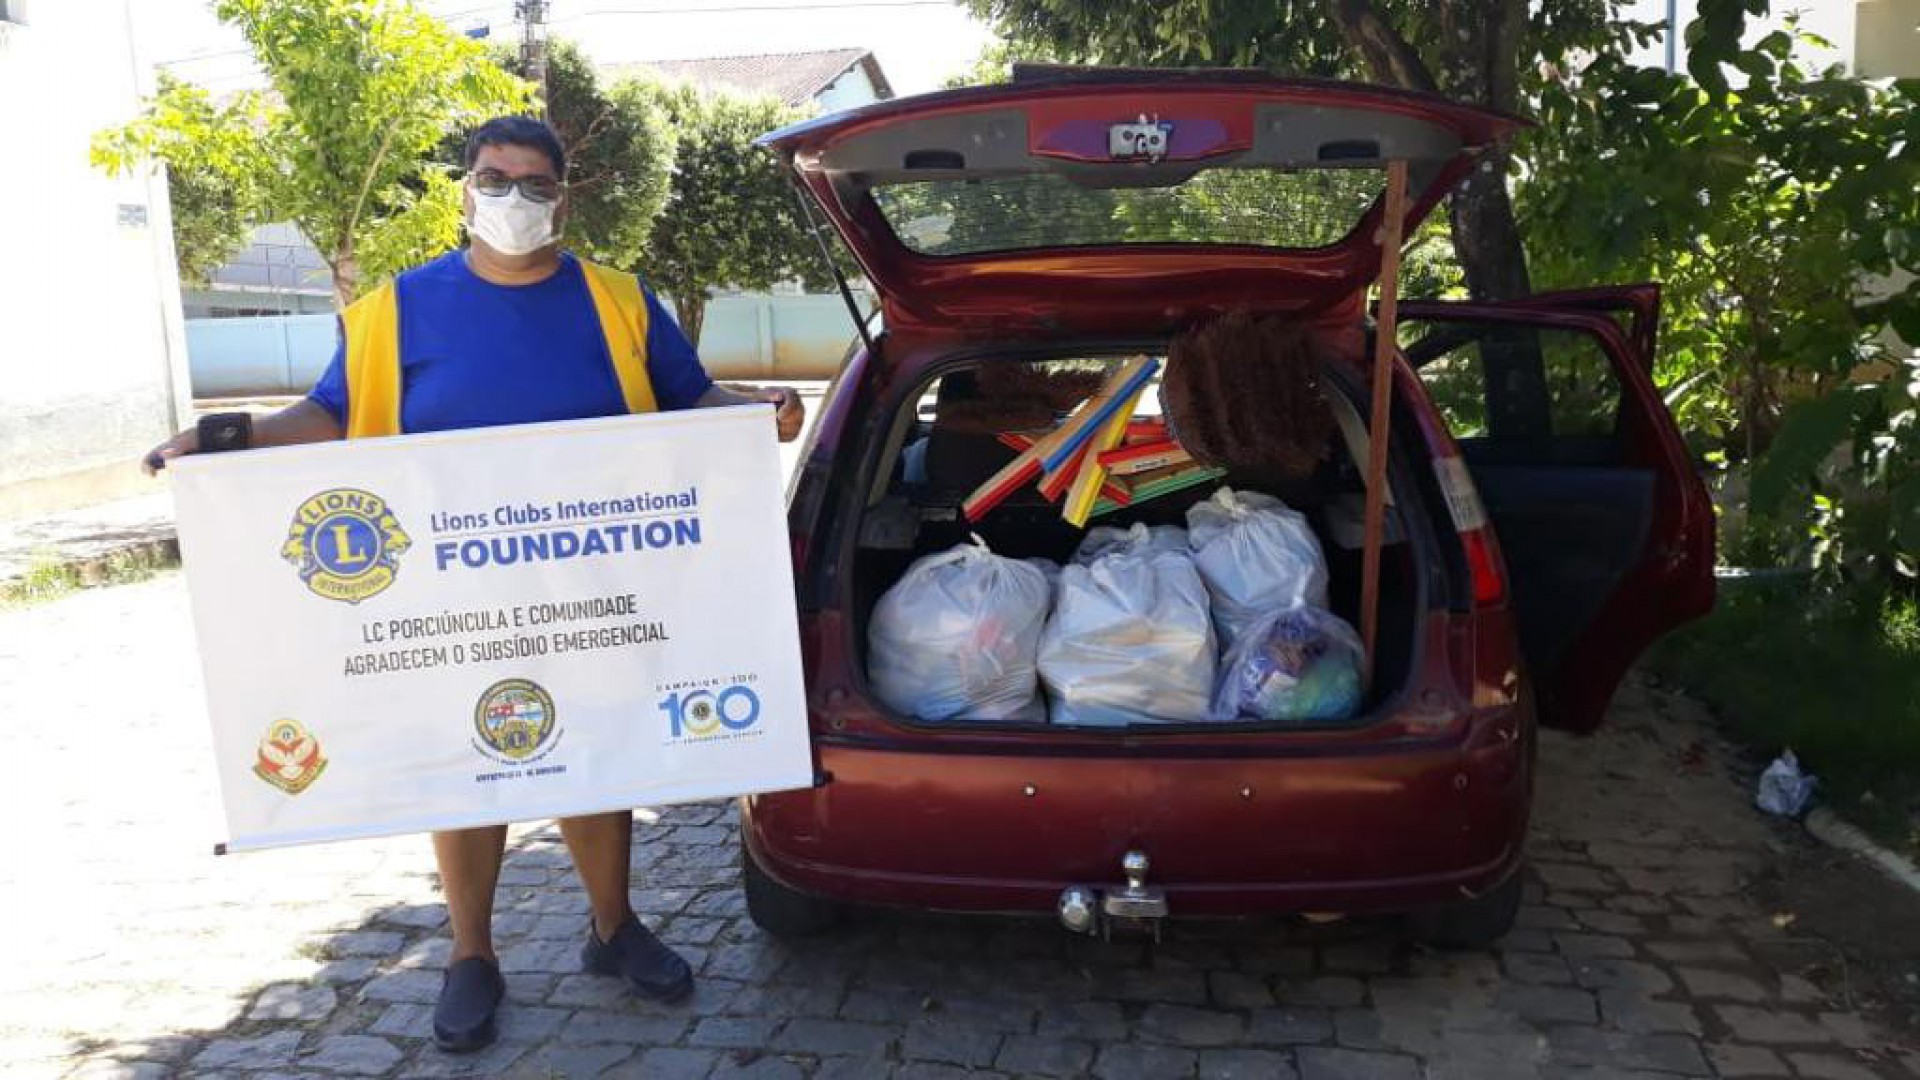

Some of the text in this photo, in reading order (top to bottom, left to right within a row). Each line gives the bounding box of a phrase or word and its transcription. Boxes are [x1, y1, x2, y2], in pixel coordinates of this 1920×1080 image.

[303, 493, 378, 520] LIONS
[431, 486, 697, 532] Lions Clubs International
[329, 524, 367, 563] L
[434, 518, 702, 571] FOUNDATION
[363, 594, 638, 643] LC PORCIÚNCULA E COMUNIDADE
[344, 621, 670, 676] AGRADECEM O SUBSÍDIO EMERGENCIAL
[658, 685, 760, 738] 100
